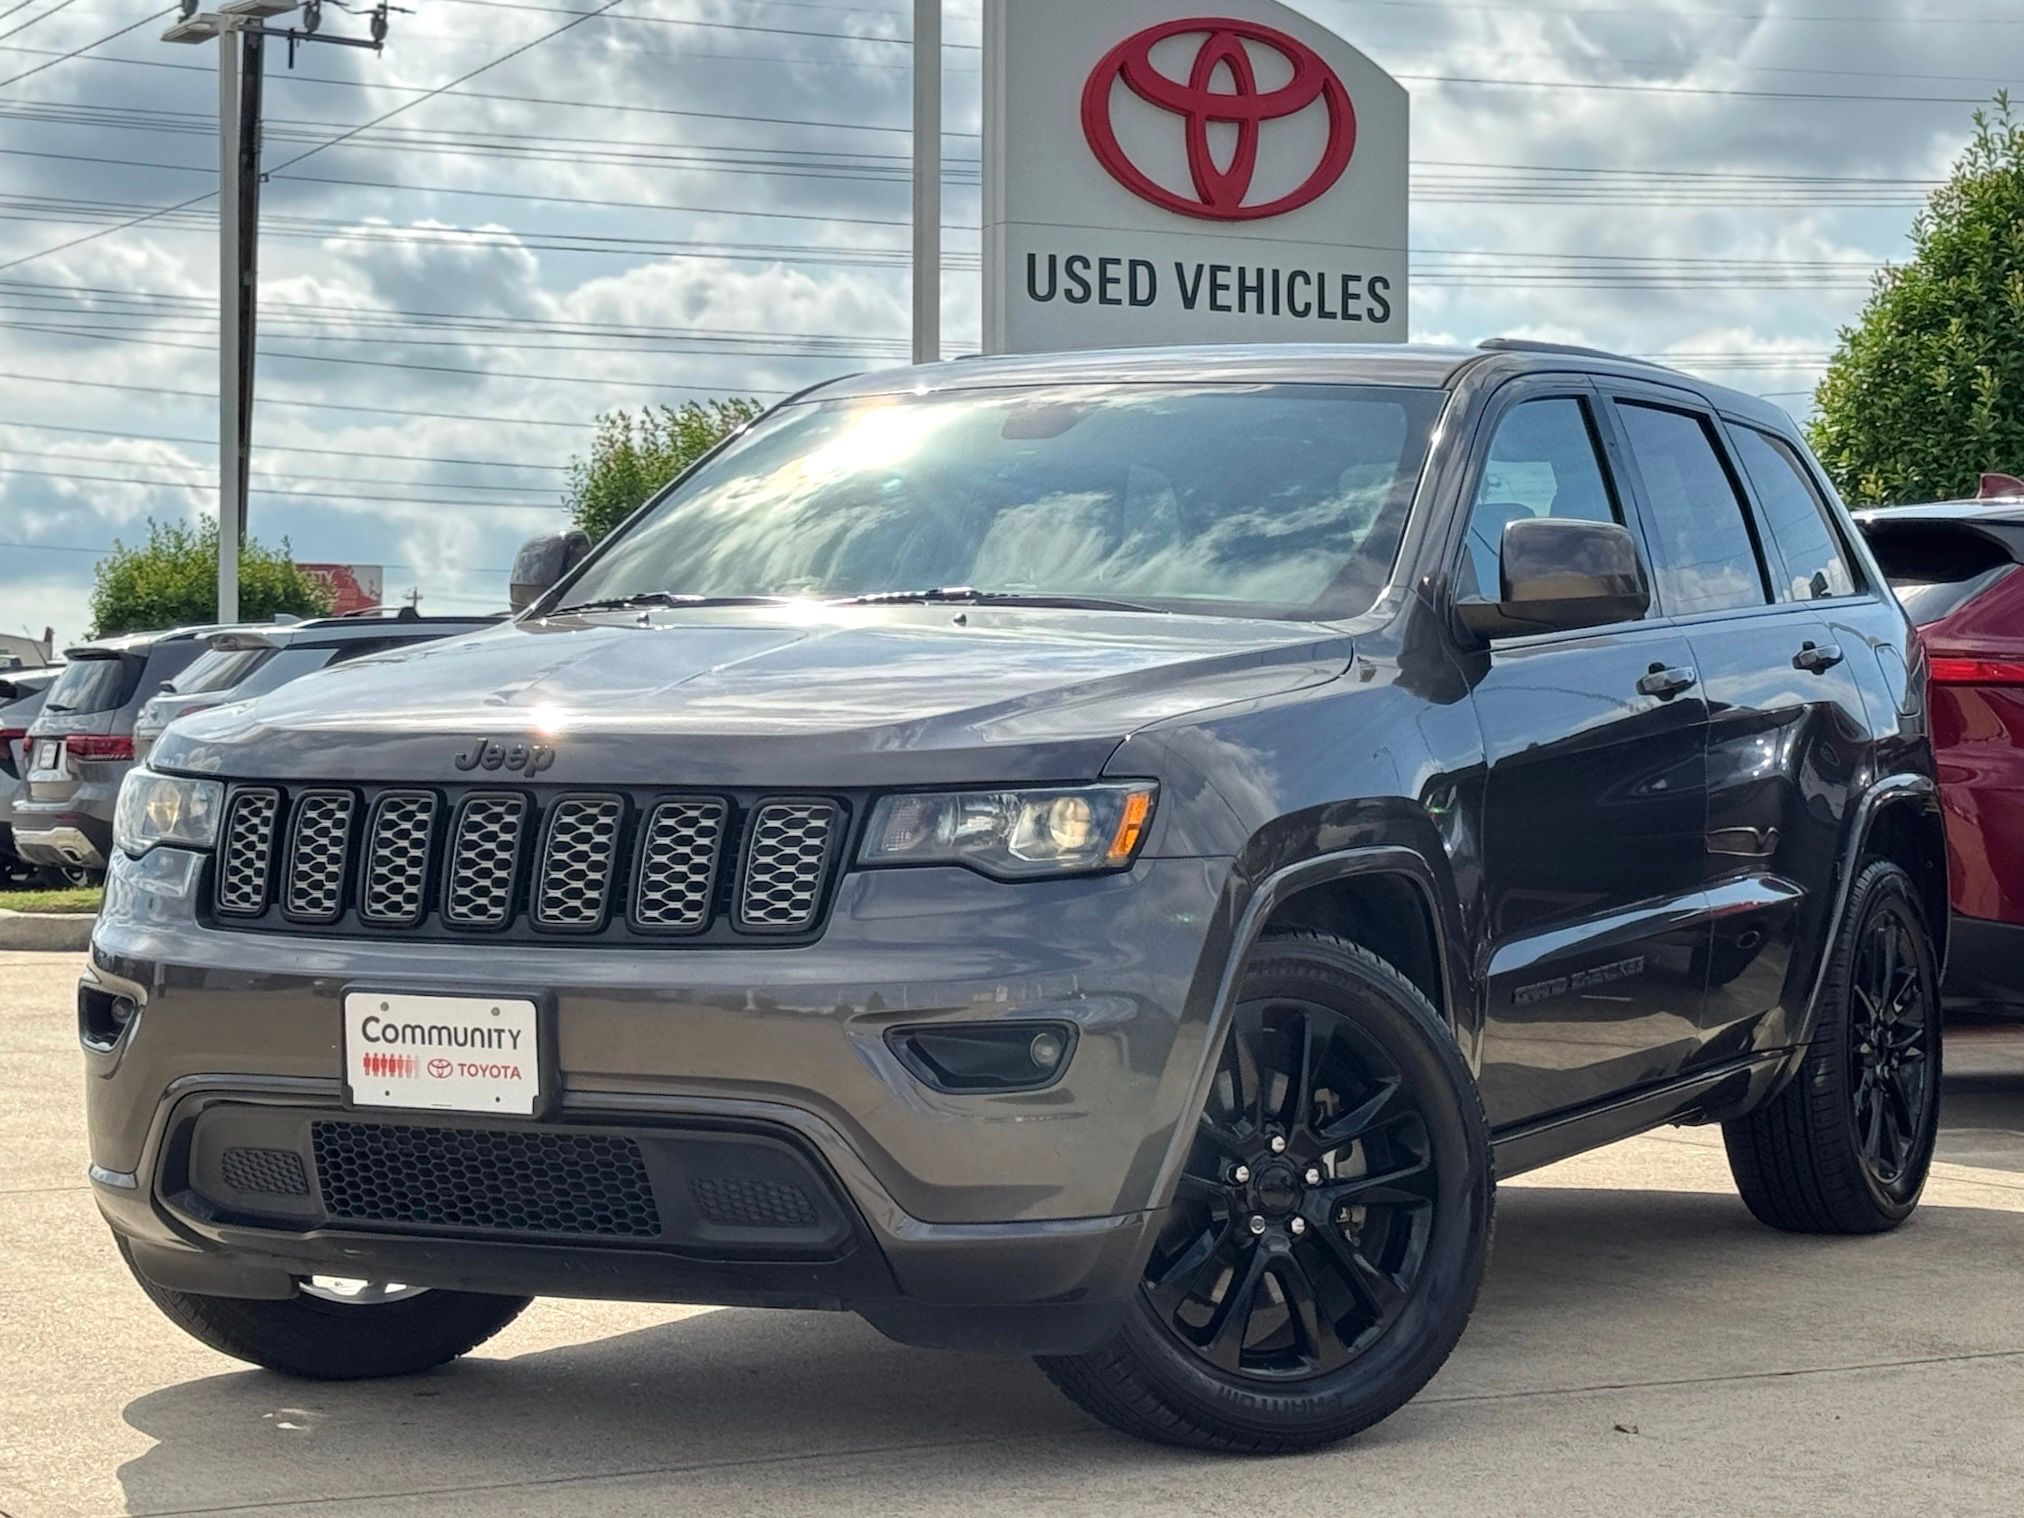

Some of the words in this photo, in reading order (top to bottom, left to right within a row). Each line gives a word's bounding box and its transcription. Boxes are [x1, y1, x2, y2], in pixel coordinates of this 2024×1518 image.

[1026, 253, 1157, 308] USED
[1174, 261, 1391, 324] VEHICLES
[455, 737, 556, 778] Jeep
[457, 1062, 522, 1080] TOYOTA
